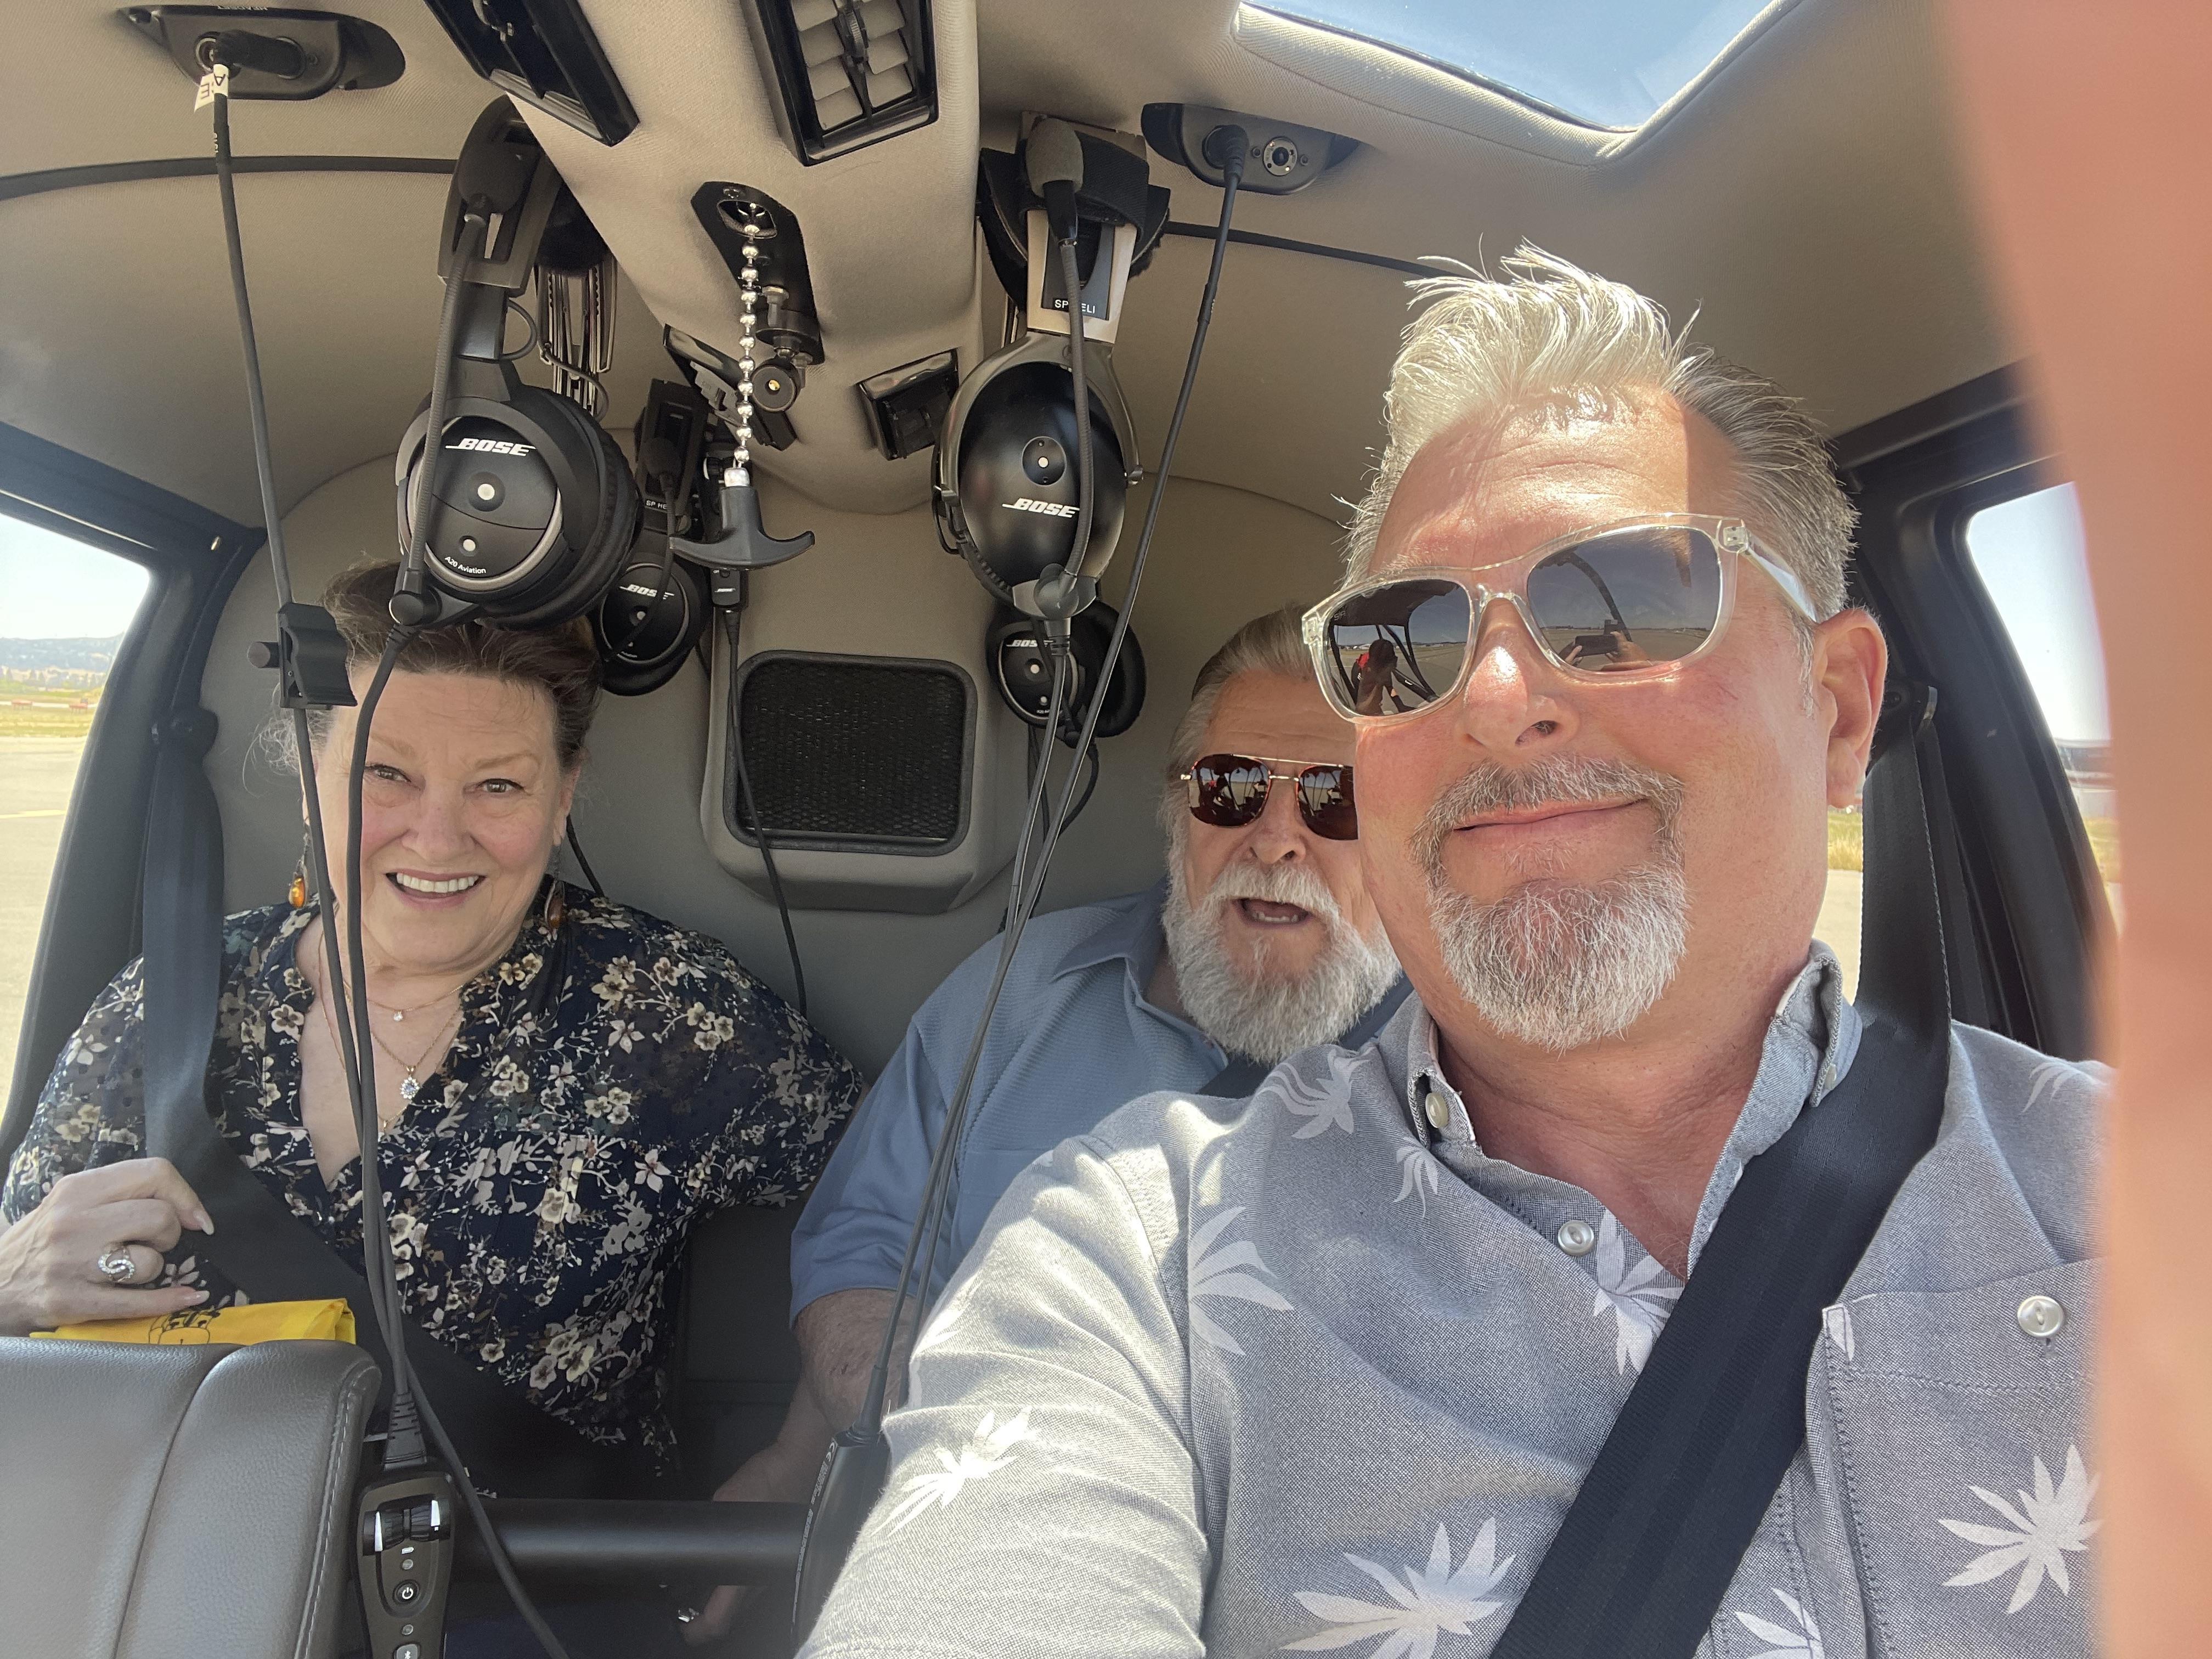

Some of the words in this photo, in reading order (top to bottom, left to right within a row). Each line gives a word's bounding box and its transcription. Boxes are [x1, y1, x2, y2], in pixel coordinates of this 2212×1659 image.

[1054, 299, 1069, 308] SP
[445, 438, 536, 456] BOSE
[1002, 498, 1080, 518] BOSE
[444, 556, 458, 567] A20
[458, 564, 487, 574] Aviation
